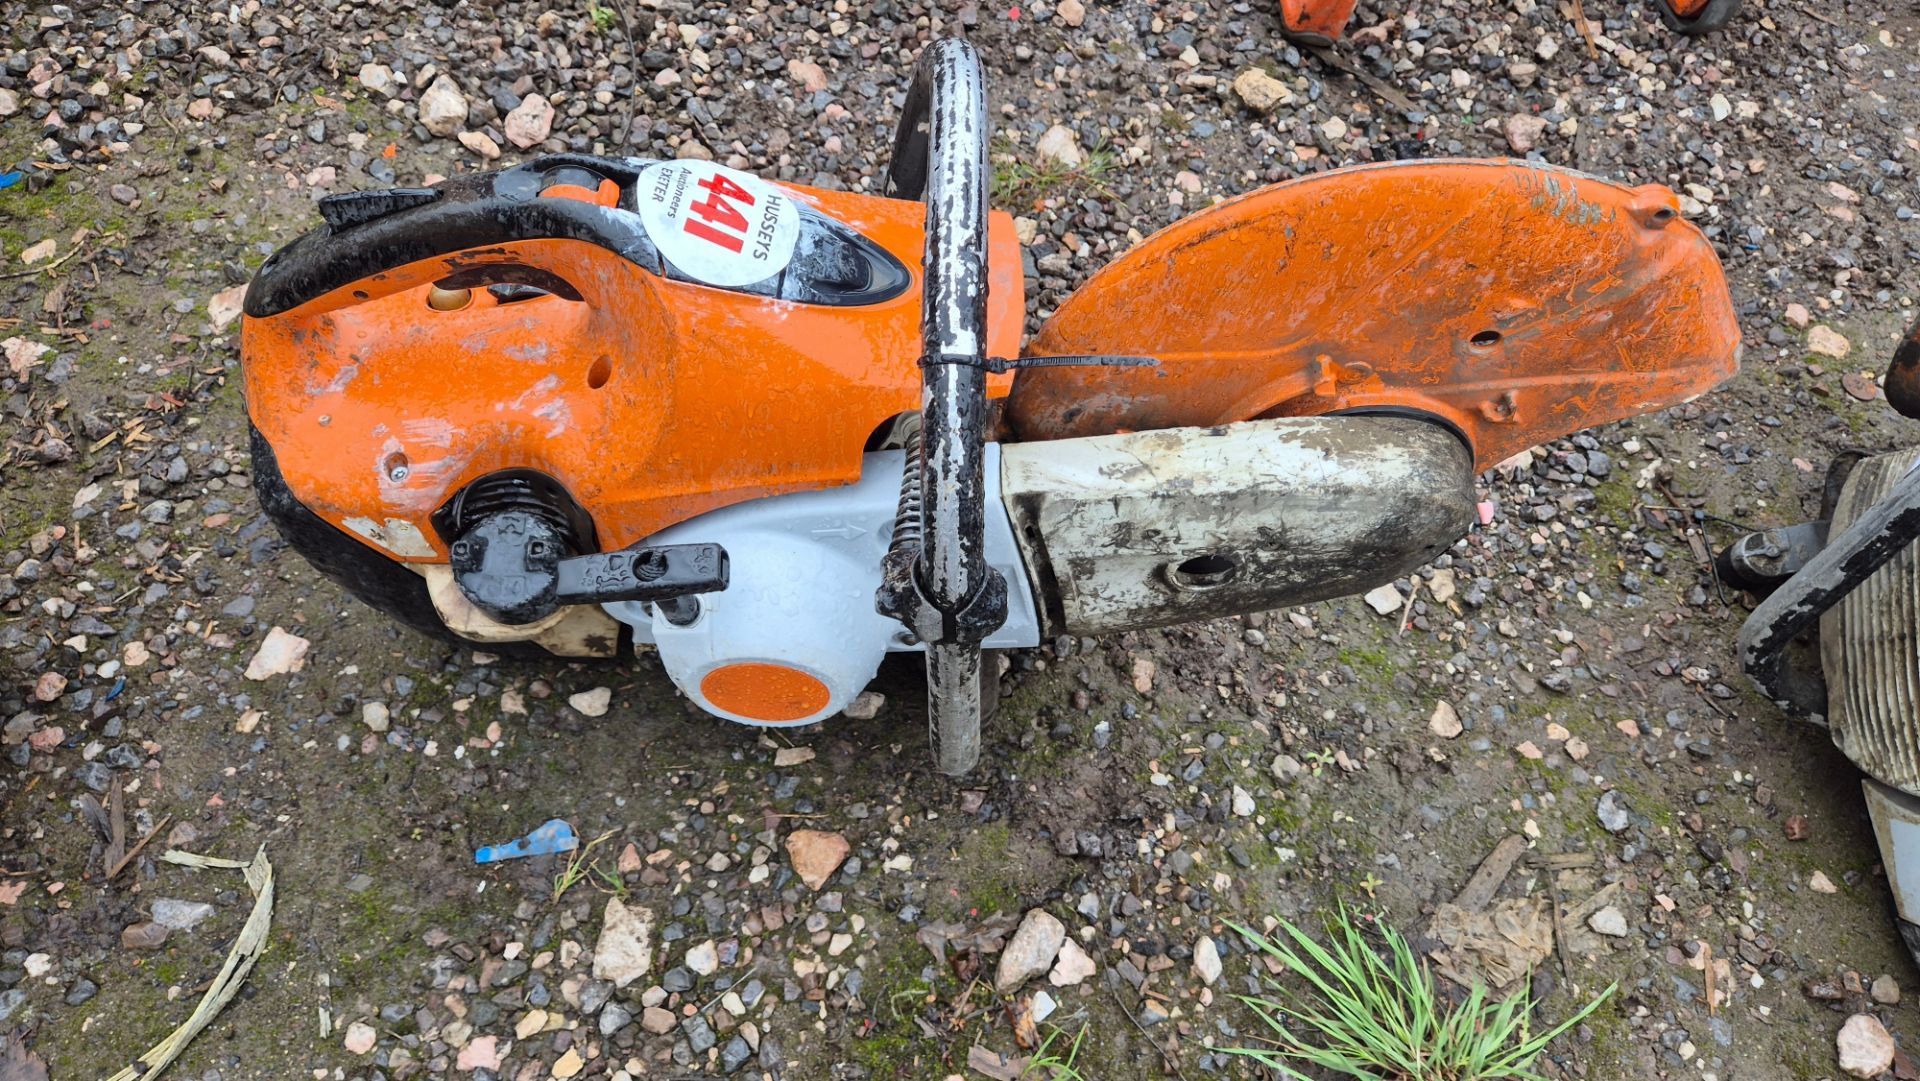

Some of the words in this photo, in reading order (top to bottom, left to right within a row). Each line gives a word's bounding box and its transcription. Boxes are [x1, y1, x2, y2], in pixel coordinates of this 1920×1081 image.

[652, 167, 673, 203] EXETER
[667, 167, 692, 219] Auctioneers
[683, 172, 756, 254] 441
[753, 194, 782, 261] HUSSEYS
